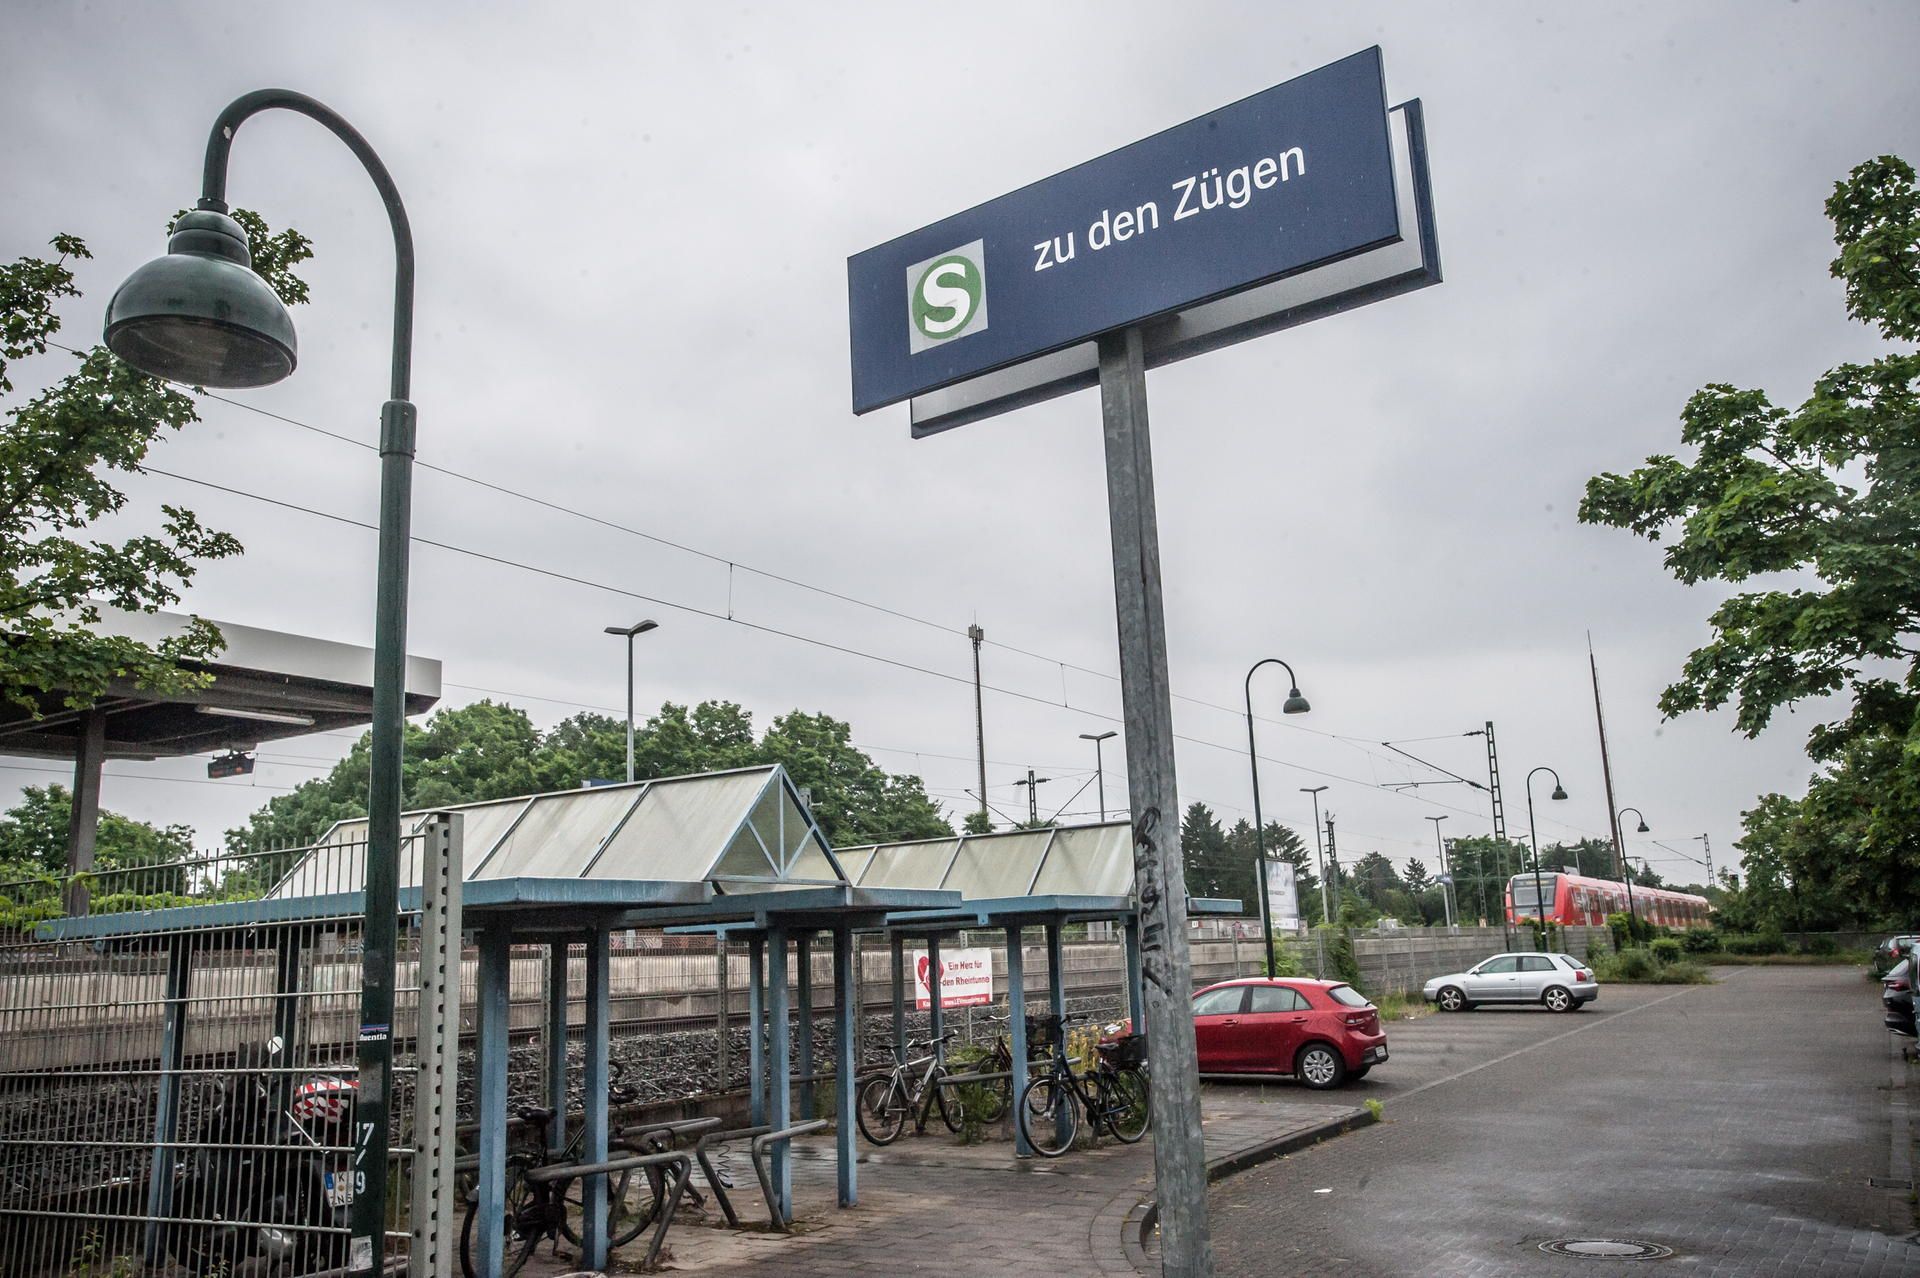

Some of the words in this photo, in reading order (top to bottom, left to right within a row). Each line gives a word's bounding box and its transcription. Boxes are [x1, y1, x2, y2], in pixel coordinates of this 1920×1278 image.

[1033, 231, 1075, 272] zu
[1088, 201, 1159, 252] den
[1172, 146, 1306, 222] Zügen
[923, 262, 970, 333] S
[942, 978, 954, 986] den
[948, 961, 959, 971] Ein
[960, 960, 973, 970] Herz
[974, 960, 983, 969] für
